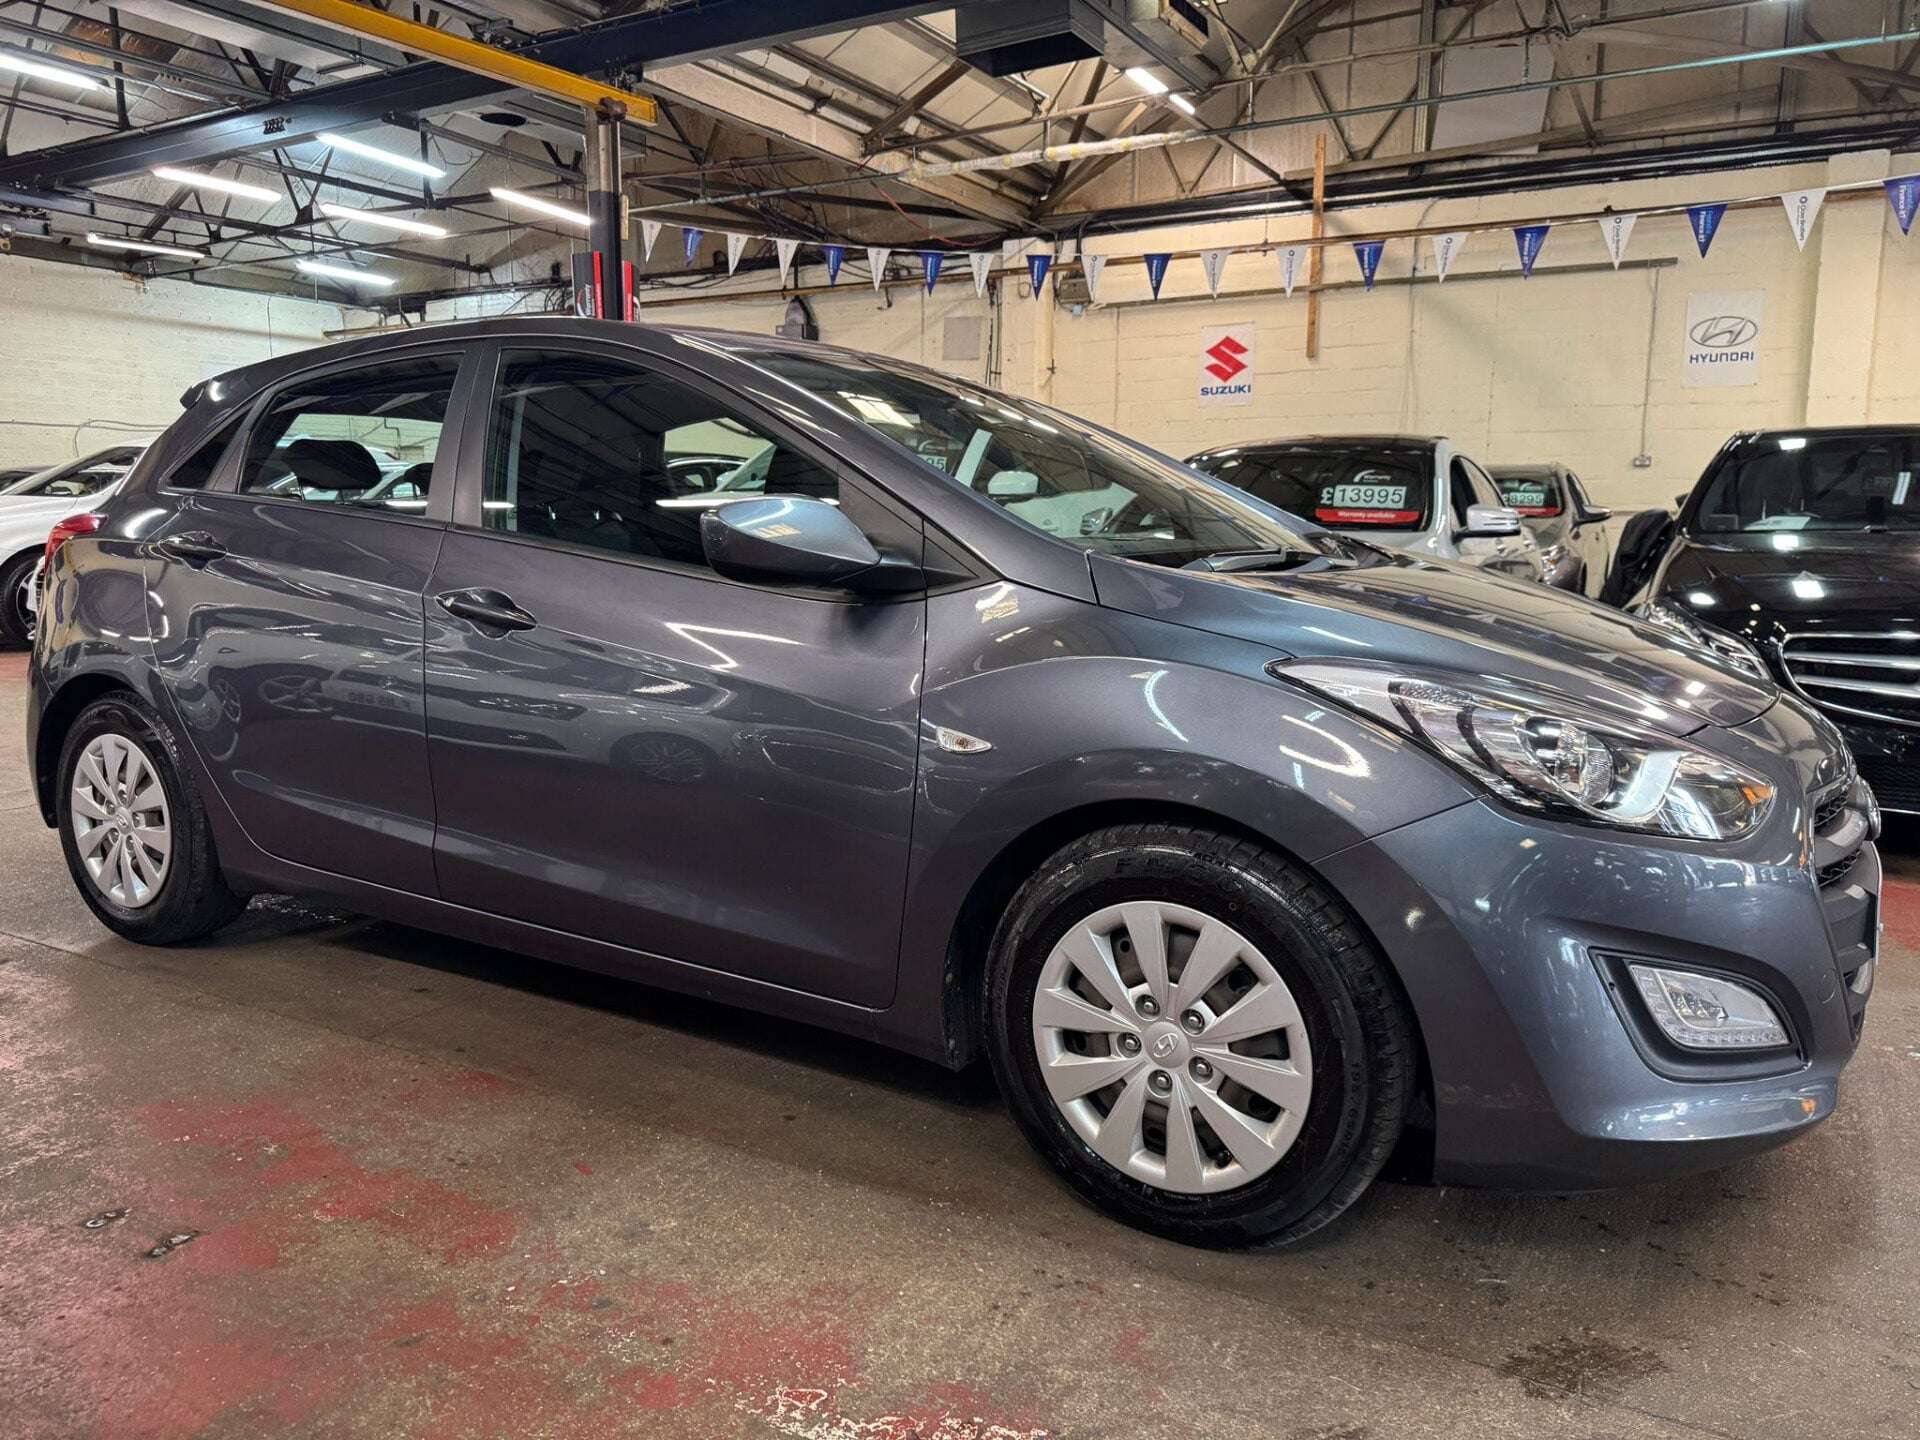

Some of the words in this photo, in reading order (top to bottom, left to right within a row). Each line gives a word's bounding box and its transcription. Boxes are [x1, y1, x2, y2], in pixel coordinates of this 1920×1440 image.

[1689, 351, 1754, 364] HYUNDAI
[1200, 384, 1251, 396] SUZUKI
[1320, 486, 1404, 505] £13995
